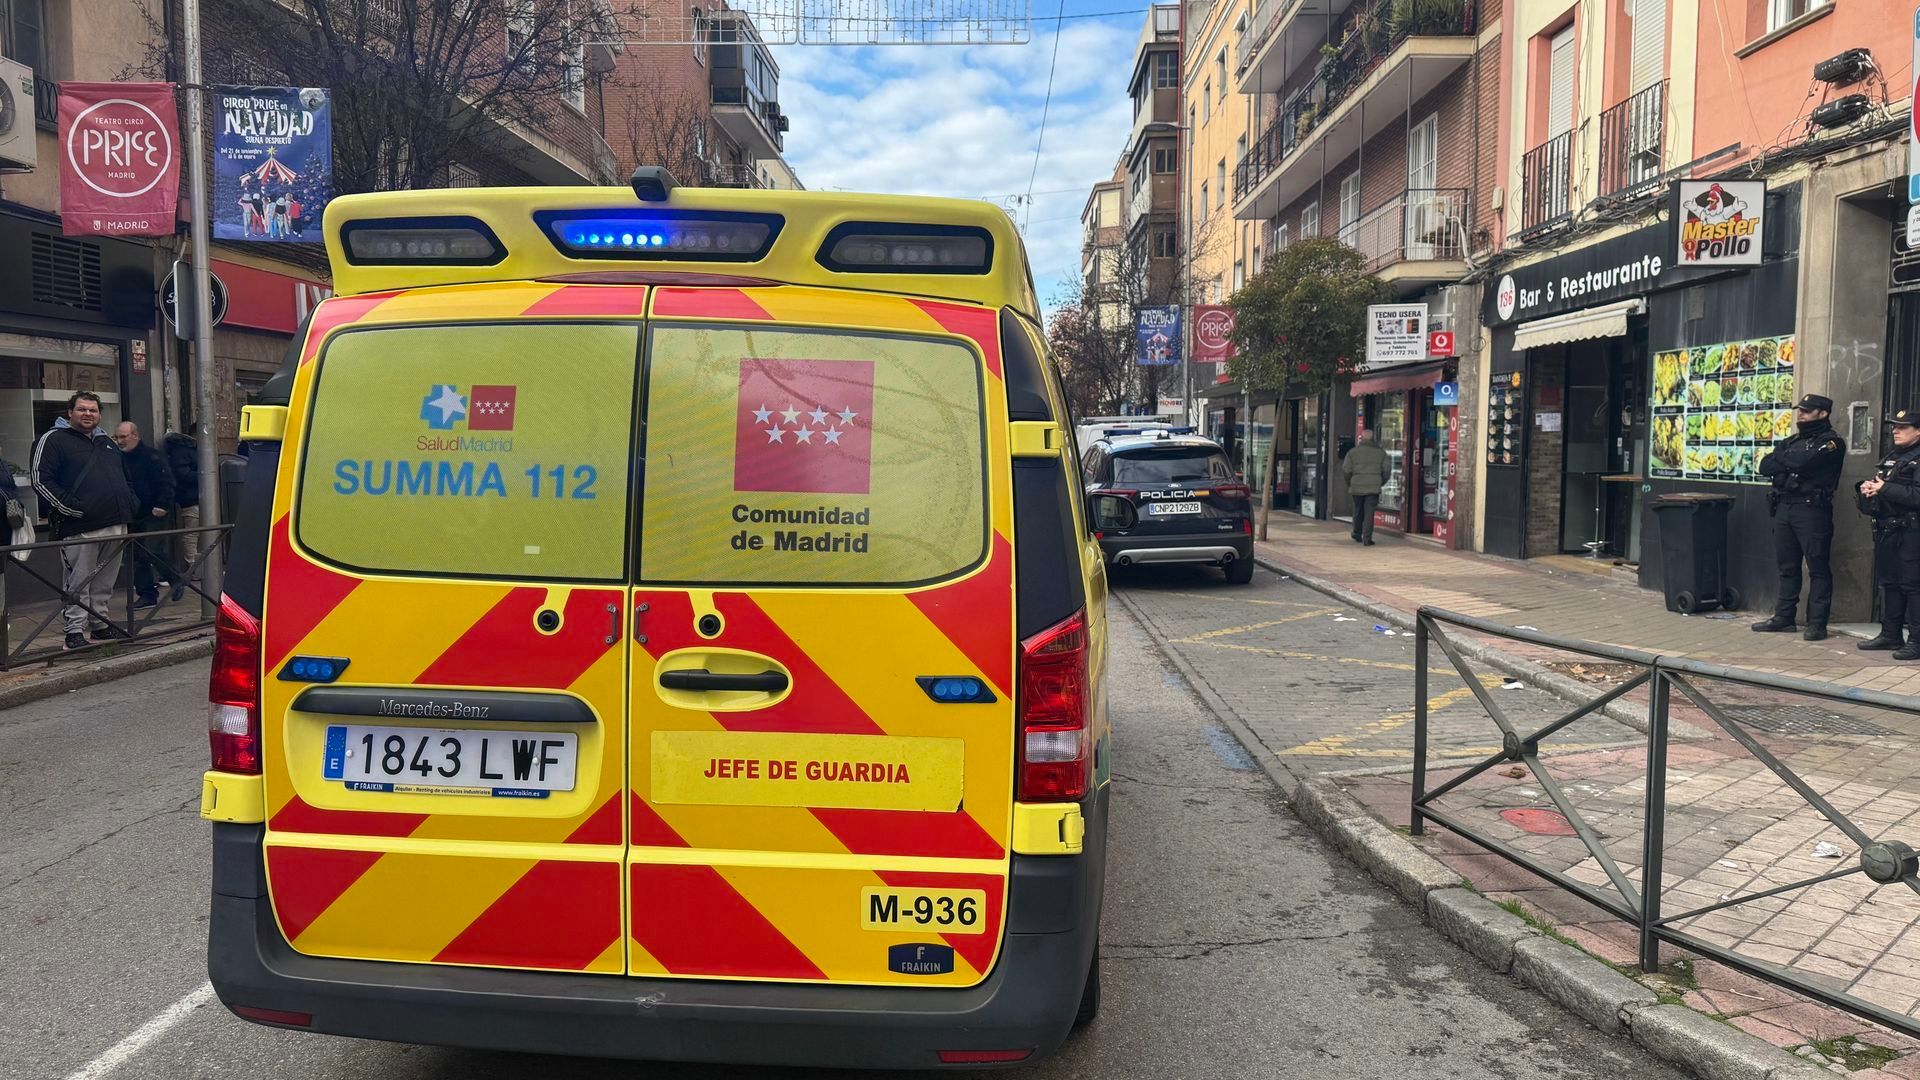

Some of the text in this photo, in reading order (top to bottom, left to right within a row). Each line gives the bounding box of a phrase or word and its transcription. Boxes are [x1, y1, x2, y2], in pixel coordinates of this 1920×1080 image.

[223, 98, 250, 108] CIRCO
[254, 98, 280, 110] PRICE
[95, 117, 122, 125] TEATRO
[224, 108, 314, 138] NAVIDAD
[83, 128, 158, 167] PRICE
[107, 220, 149, 230] MADRID
[1682, 217, 1760, 242] Master
[1695, 235, 1750, 260] Pollo
[1520, 254, 1662, 309] Bar & Restaurante
[1140, 310, 1176, 325] NAVIDAD
[416, 435, 512, 452] SaludMadrid
[332, 458, 598, 500] SUMMA 112
[1140, 490, 1196, 500] POLICIA
[732, 504, 870, 526] Comunidad
[1154, 503, 1200, 514] CNP2129ZB
[730, 530, 868, 553] de Madrid
[378, 699, 490, 718] Mercedes-Benz
[330, 758, 339, 770] E
[362, 733, 565, 782] 1843 LWF
[704, 758, 910, 784] JEFE DE GUARDIA
[870, 894, 978, 926] M-936
[901, 962, 941, 972] FRAIKIN
